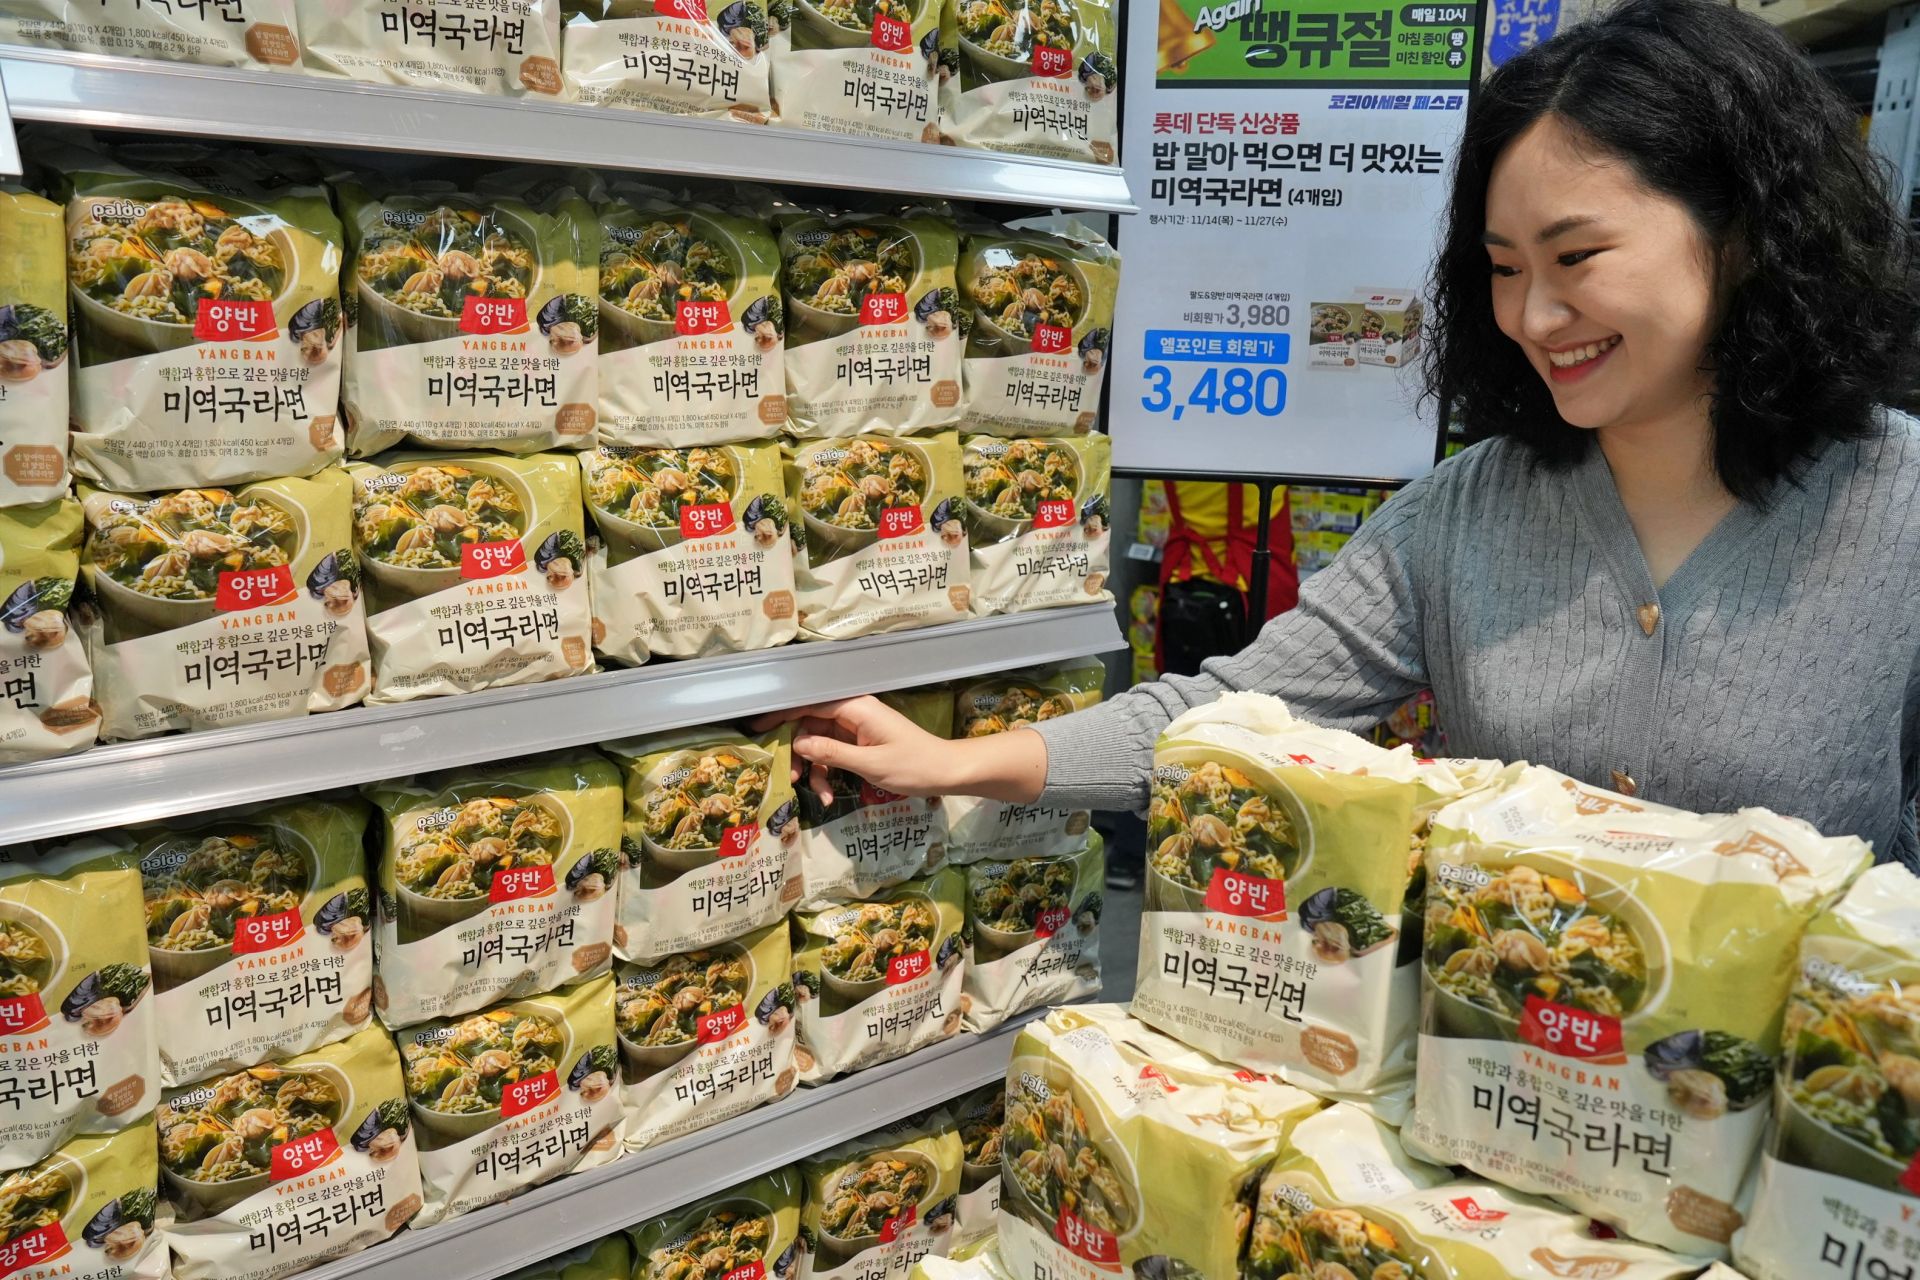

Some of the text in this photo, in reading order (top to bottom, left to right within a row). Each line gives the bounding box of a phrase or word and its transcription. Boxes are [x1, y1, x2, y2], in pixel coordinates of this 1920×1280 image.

[513, 1, 531, 16] 더한
[1194, 0, 1262, 32] Again
[1411, 8, 1467, 22] 매일 10시
[381, 6, 525, 55] 미역국라면
[879, 21, 904, 46] 양반
[1239, 9, 1393, 70] 땡큐절
[1397, 32, 1421, 46] 아침
[1450, 32, 1466, 47] 땡
[871, 52, 912, 70] YANGBAN
[1040, 51, 1065, 71] 양반
[1395, 51, 1463, 66] 미친 할인 큐
[623, 51, 739, 102] 미역국라면
[843, 77, 929, 122] 미역국라면
[1328, 95, 1463, 110] 코리아세일 페스타
[1012, 104, 1088, 141] 미역국라면
[1153, 113, 1300, 135] 롯데 단독 신상품
[1153, 142, 1444, 174] 밥 말아 먹으면 더 맛있는
[1151, 177, 1343, 208] 미역국라면 (4개입)
[92, 199, 147, 222] paldo
[383, 209, 426, 226] paldo
[1191, 214, 1234, 227] 11/14(목)
[1245, 214, 1288, 227] 11/27(수)
[868, 298, 899, 318] 양반
[1227, 291, 1264, 302] 미역국라면
[1265, 292, 1290, 303] (4개입)
[210, 306, 259, 332] 양반
[475, 303, 515, 326] 양반
[682, 306, 719, 328] 양반
[1184, 304, 1290, 329] 비회원가 3,980
[463, 340, 527, 352] YANGBAN
[677, 340, 735, 350] YANGBAN
[860, 330, 909, 339] YANGBAN
[1039, 328, 1064, 348] 양반
[1160, 337, 1275, 358] 엘포인트 회원가
[198, 349, 277, 361] YANGBAN
[424, 355, 561, 371] 백합과 홍합으로 깊은 맛을 더한
[158, 367, 310, 382] 백합과 홍합으로 깊은 맛을 더한
[837, 354, 932, 388] 미역국라면
[427, 372, 558, 408] 미역국라면
[653, 368, 759, 402] 미역국라면
[1006, 379, 1082, 413] 미역국라면
[1141, 365, 1287, 421] 3,480
[163, 384, 309, 424] 미역국라면
[364, 473, 409, 492] paldo
[688, 508, 723, 530] 양반
[885, 510, 914, 531] 양반
[1040, 503, 1068, 522] 양반
[472, 545, 513, 570] 양반
[684, 540, 738, 553] YANGBAN
[878, 540, 926, 554] YANGBAN
[231, 573, 279, 600] 양반
[465, 581, 528, 596] YANGBAN
[663, 565, 764, 604] 미역국라면
[858, 562, 949, 598] 미역국라면
[430, 593, 558, 619] 백합과 홍합으로 깊은 맛을 더한
[221, 611, 297, 630] YANGBAN
[438, 609, 559, 655] 미역국라면
[176, 620, 339, 655] 백합과 홍합으로 깊은 맛을 더한
[14, 654, 43, 669] 더한
[184, 637, 331, 690] 미역국라면
[1156, 763, 1191, 782] paldo
[416, 808, 458, 830] paldo
[501, 870, 542, 894] 양반
[1438, 860, 1491, 888] paldo
[1223, 877, 1270, 911] 양반
[490, 902, 555, 918] YANGBAN
[247, 916, 292, 944] 양반
[1204, 918, 1283, 944] YANGBAN
[463, 918, 575, 969] 미역국라면
[1163, 927, 1318, 980] 백합과 홍합으로 깊은 맛을 더한
[237, 946, 305, 972] YANGBAN
[895, 955, 924, 977] 양반
[199, 954, 345, 999] 백합과 홍합으로 깊은 맛을 더한
[1163, 950, 1307, 1023] 미역국라면
[206, 971, 344, 1030] 미역국라면
[706, 1010, 737, 1036] 양반
[867, 993, 945, 1042] 미역국라면
[1538, 1007, 1603, 1053] 양반
[14, 1041, 100, 1071] 깊은 맛을 더한
[674, 1051, 776, 1106] 미역국라면
[1522, 1050, 1620, 1091] YANGBAN
[169, 1087, 217, 1111] paldo
[512, 1078, 548, 1105] 양반
[1467, 1056, 1684, 1133] 백합과 홍합으로 깊은 맛을 더한
[504, 1104, 559, 1131] YANGBAN
[1472, 1083, 1673, 1178] 미역국라면
[283, 1137, 325, 1168] 양반
[475, 1121, 590, 1181] 미역국라면
[275, 1167, 347, 1196] YANGBAN
[239, 1167, 387, 1226] 백합과 홍합으로 깊은 맛을 더한
[249, 1183, 387, 1254] 미역국라면
[1065, 1216, 1105, 1258] 양반
